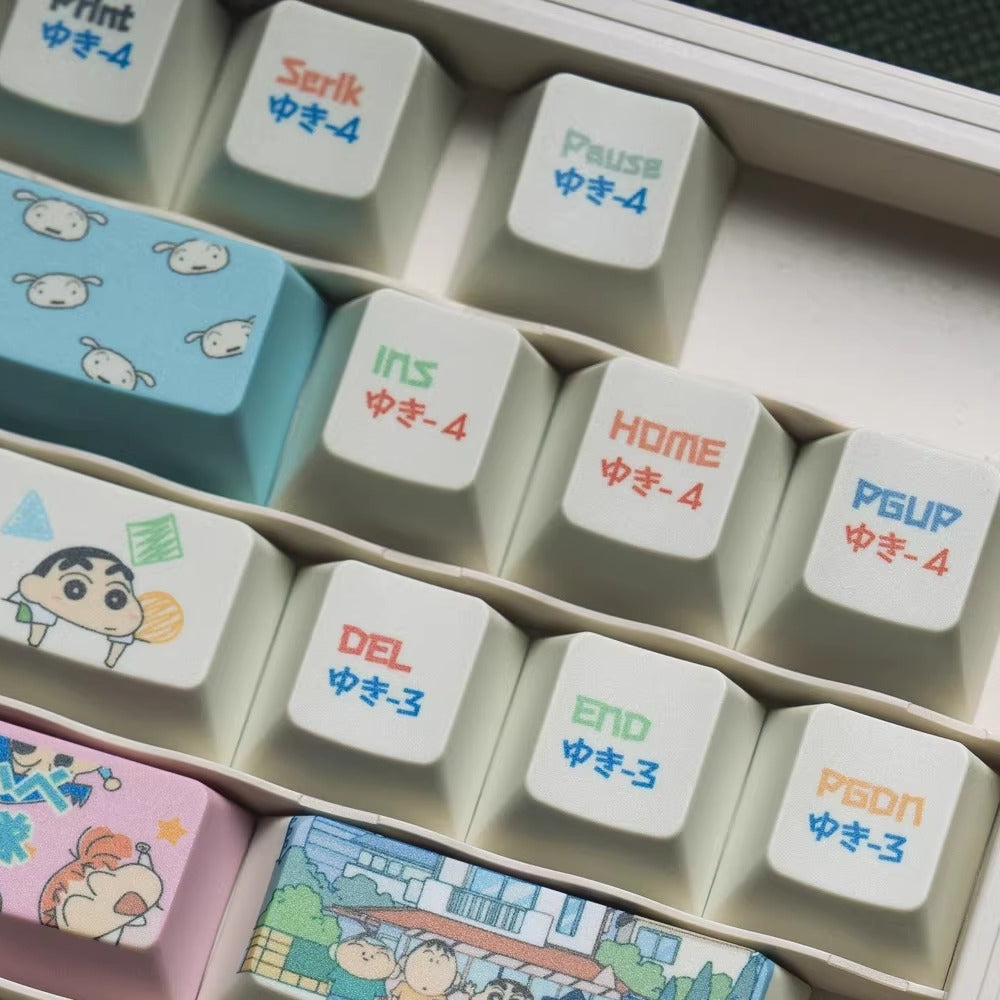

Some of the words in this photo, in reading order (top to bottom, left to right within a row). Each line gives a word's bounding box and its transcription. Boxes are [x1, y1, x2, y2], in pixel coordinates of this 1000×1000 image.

[560, 128, 664, 181] Pause
[608, 409, 727, 468] HOME
[852, 478, 963, 532] PGUP
[337, 624, 412, 674] DEL
